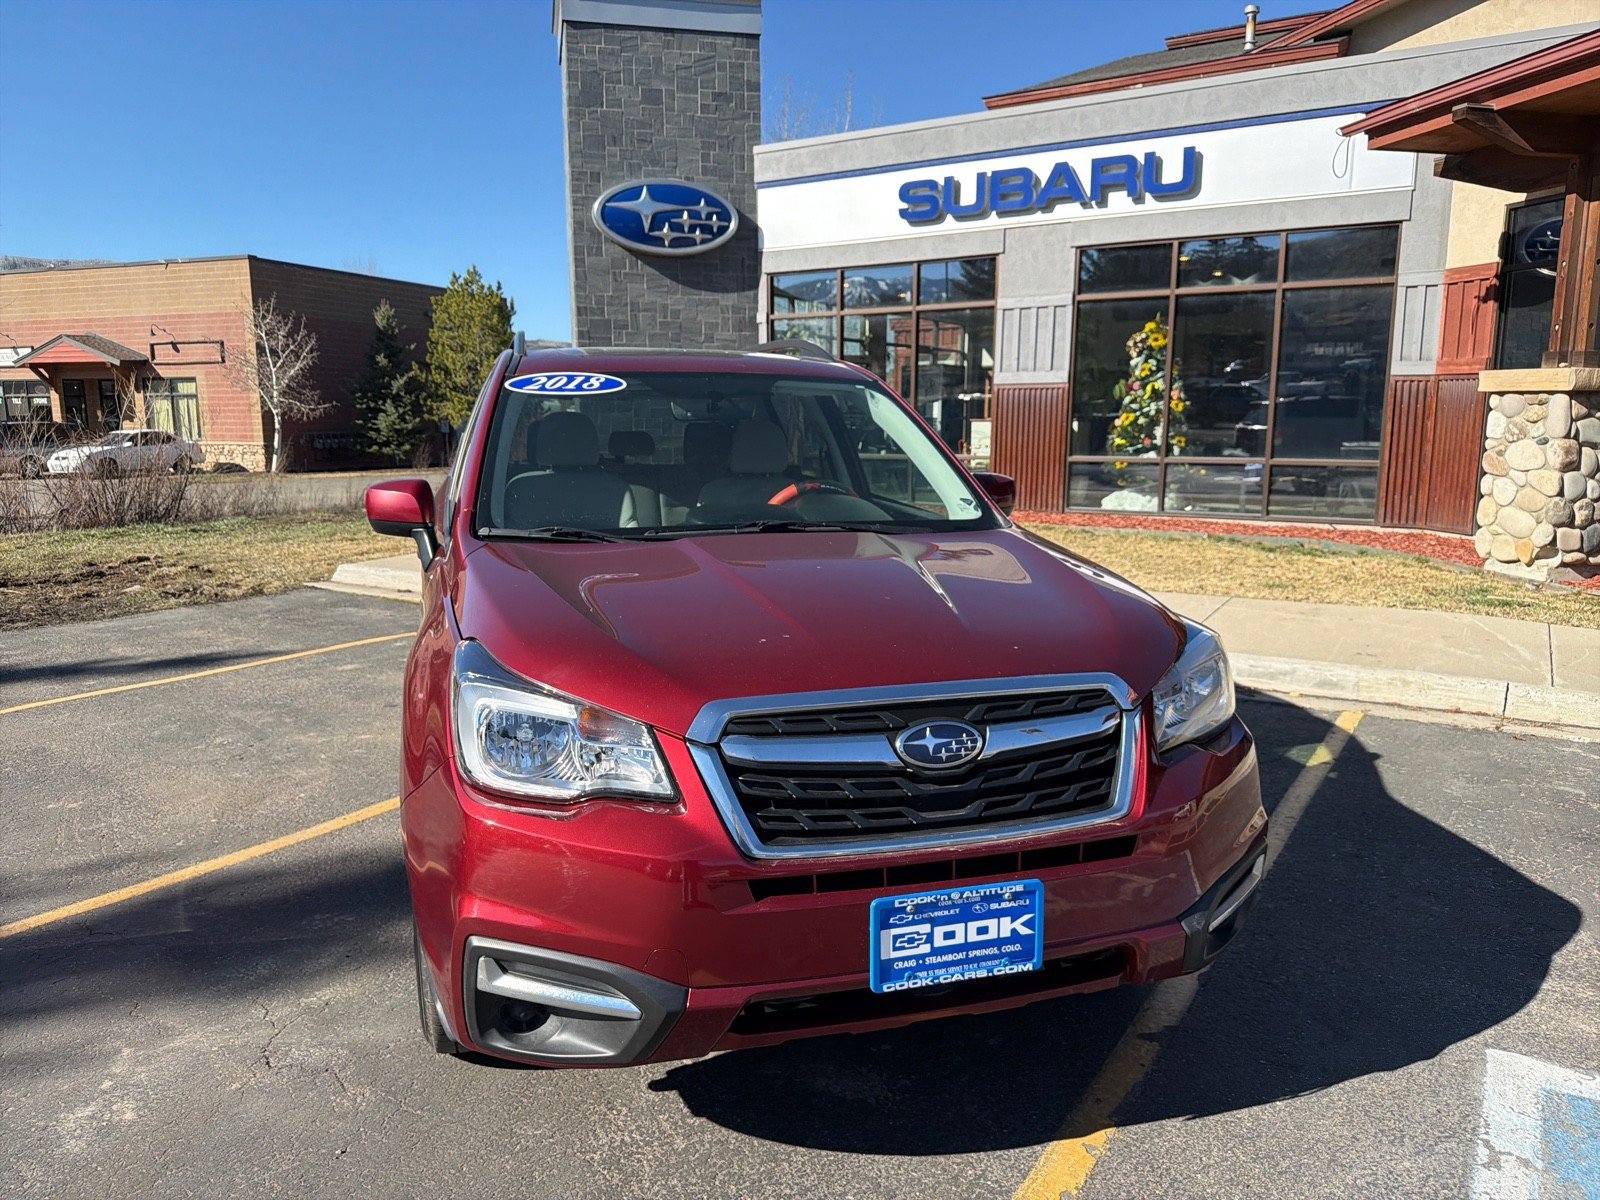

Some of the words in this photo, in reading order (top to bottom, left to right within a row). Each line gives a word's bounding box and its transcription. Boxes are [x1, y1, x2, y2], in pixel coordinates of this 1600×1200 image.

[898, 146, 1202, 226] SUBARU
[522, 376, 606, 390] 2018
[950, 891, 961, 900] @
[963, 884, 1024, 898] ALTITUDE
[914, 908, 960, 920] CHEVROLET
[989, 898, 1030, 910] SUBARU
[880, 913, 1035, 960] COOK
[893, 959, 917, 969] CRAIG
[925, 951, 967, 965] STEAMBOAT
[1001, 943, 1023, 953] COLO.
[882, 963, 1034, 993] COOK-CARS.COM
